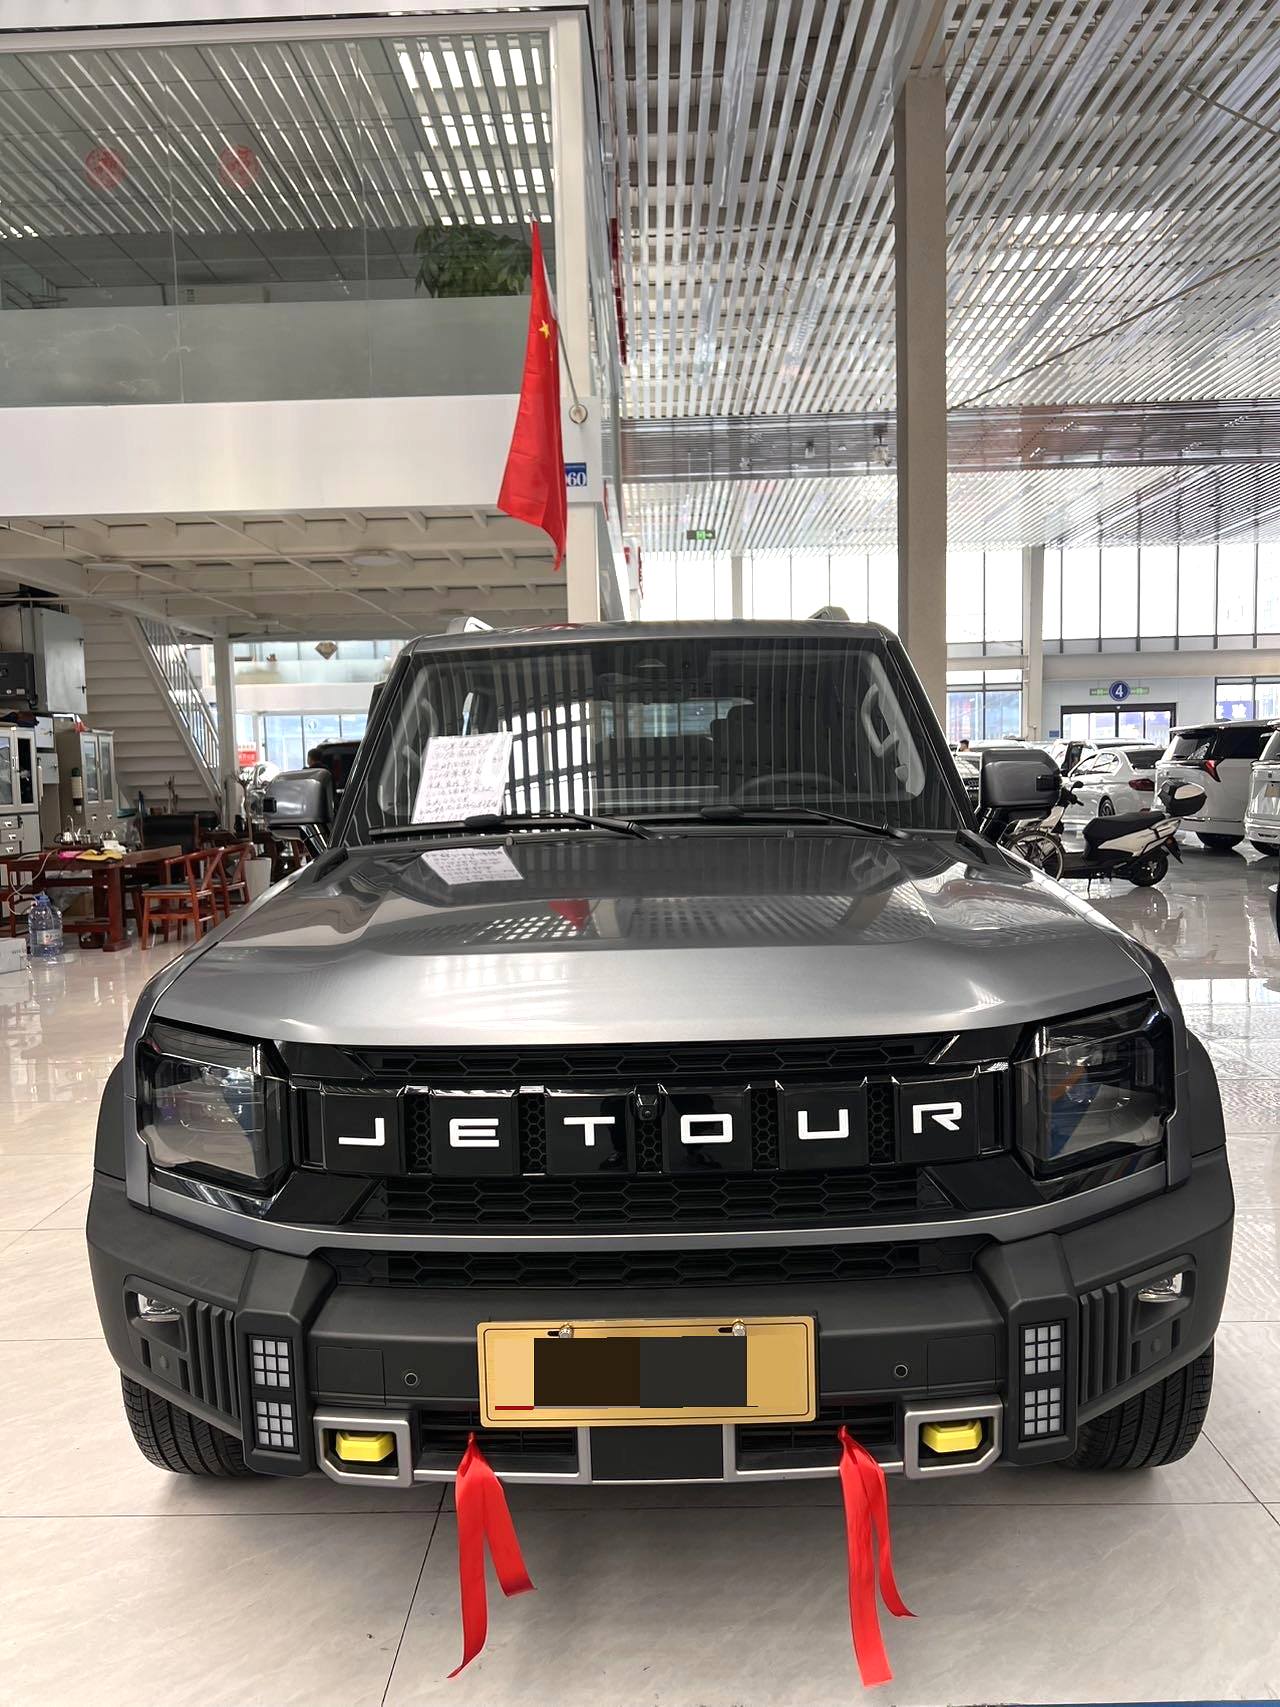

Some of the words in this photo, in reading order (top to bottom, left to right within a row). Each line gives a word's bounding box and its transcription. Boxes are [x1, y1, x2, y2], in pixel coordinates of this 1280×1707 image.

[565, 471, 587, 487] 60
[1115, 684, 1124, 698] 4
[338, 1101, 963, 1148] JETOUR
